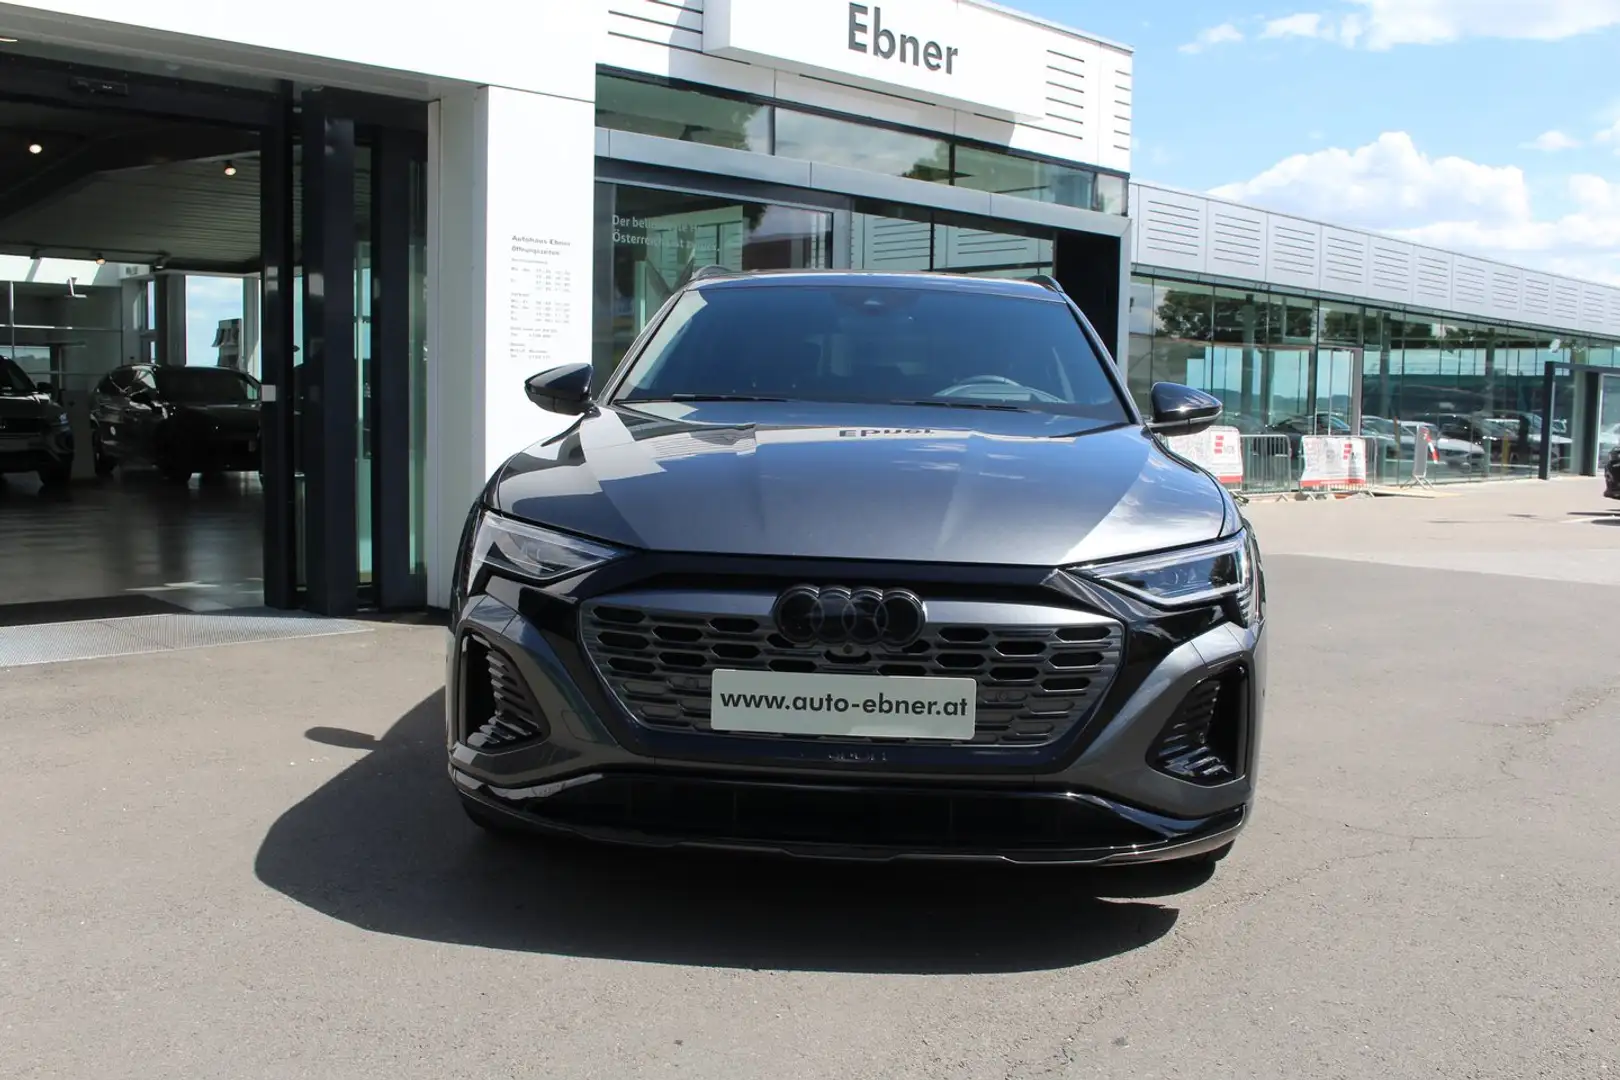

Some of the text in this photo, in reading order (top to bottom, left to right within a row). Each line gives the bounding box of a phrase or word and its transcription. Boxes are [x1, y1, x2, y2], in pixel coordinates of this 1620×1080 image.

[848, 2, 958, 75] Ebner
[612, 214, 630, 227] Der
[511, 235, 547, 244] Autohaus
[511, 244, 560, 255] Öffnungszeiten
[720, 691, 967, 716] www.auto-ebner.at
